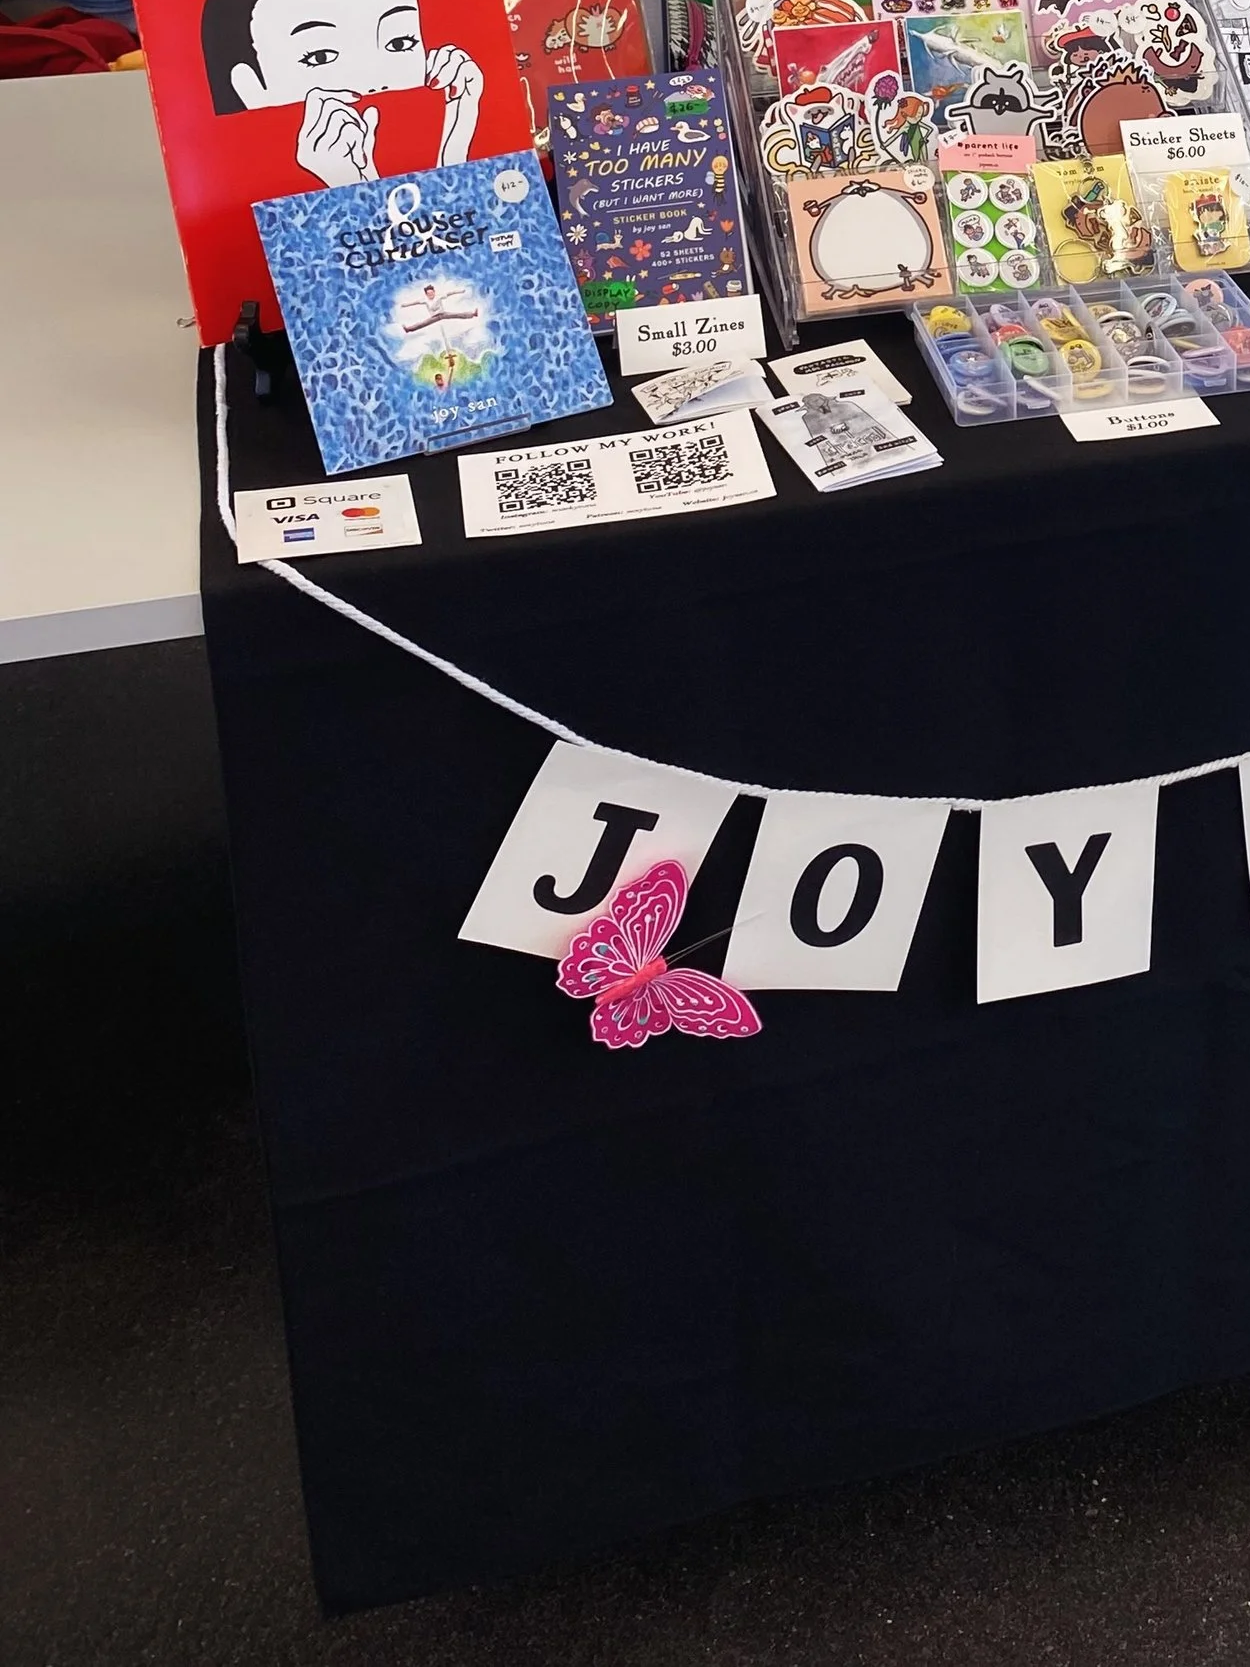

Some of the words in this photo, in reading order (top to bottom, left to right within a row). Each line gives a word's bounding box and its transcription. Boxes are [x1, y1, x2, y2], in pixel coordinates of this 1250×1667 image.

[1130, 131, 1183, 147] Sticker
[1189, 127, 1236, 142] Sheets
[616, 144, 622, 156] I
[629, 139, 672, 155] HAVE
[1002, 142, 1019, 150] life
[1167, 145, 1206, 160] $6.00
[585, 160, 629, 176] TOO
[640, 148, 707, 172] MANY
[610, 172, 685, 193] STICKERS
[592, 197, 618, 211] (BUT
[632, 192, 664, 205] WANT
[668, 188, 704, 200] MORE)
[613, 211, 656, 225] STICKER
[660, 209, 688, 219] BOOK
[340, 209, 477, 249] curiouser
[632, 226, 642, 235] by
[643, 224, 657, 234] joy
[673, 245, 704, 256] SHEETS
[652, 259, 673, 267] 400+
[675, 254, 715, 265] STICKERS
[584, 287, 632, 298] DISPLAY
[638, 320, 688, 342] Small
[696, 317, 745, 335] Zines
[672, 338, 717, 357] $3.00
[430, 403, 460, 423] joy
[468, 396, 498, 412] san
[1108, 409, 1175, 426] Buttons
[1127, 418, 1169, 431] $1.00
[496, 444, 591, 465] FOLLOW
[599, 438, 632, 451] MY
[642, 421, 716, 443] WORK!
[303, 492, 381, 506] Square
[271, 513, 320, 524] VISA
[532, 800, 1112, 950] JOY
